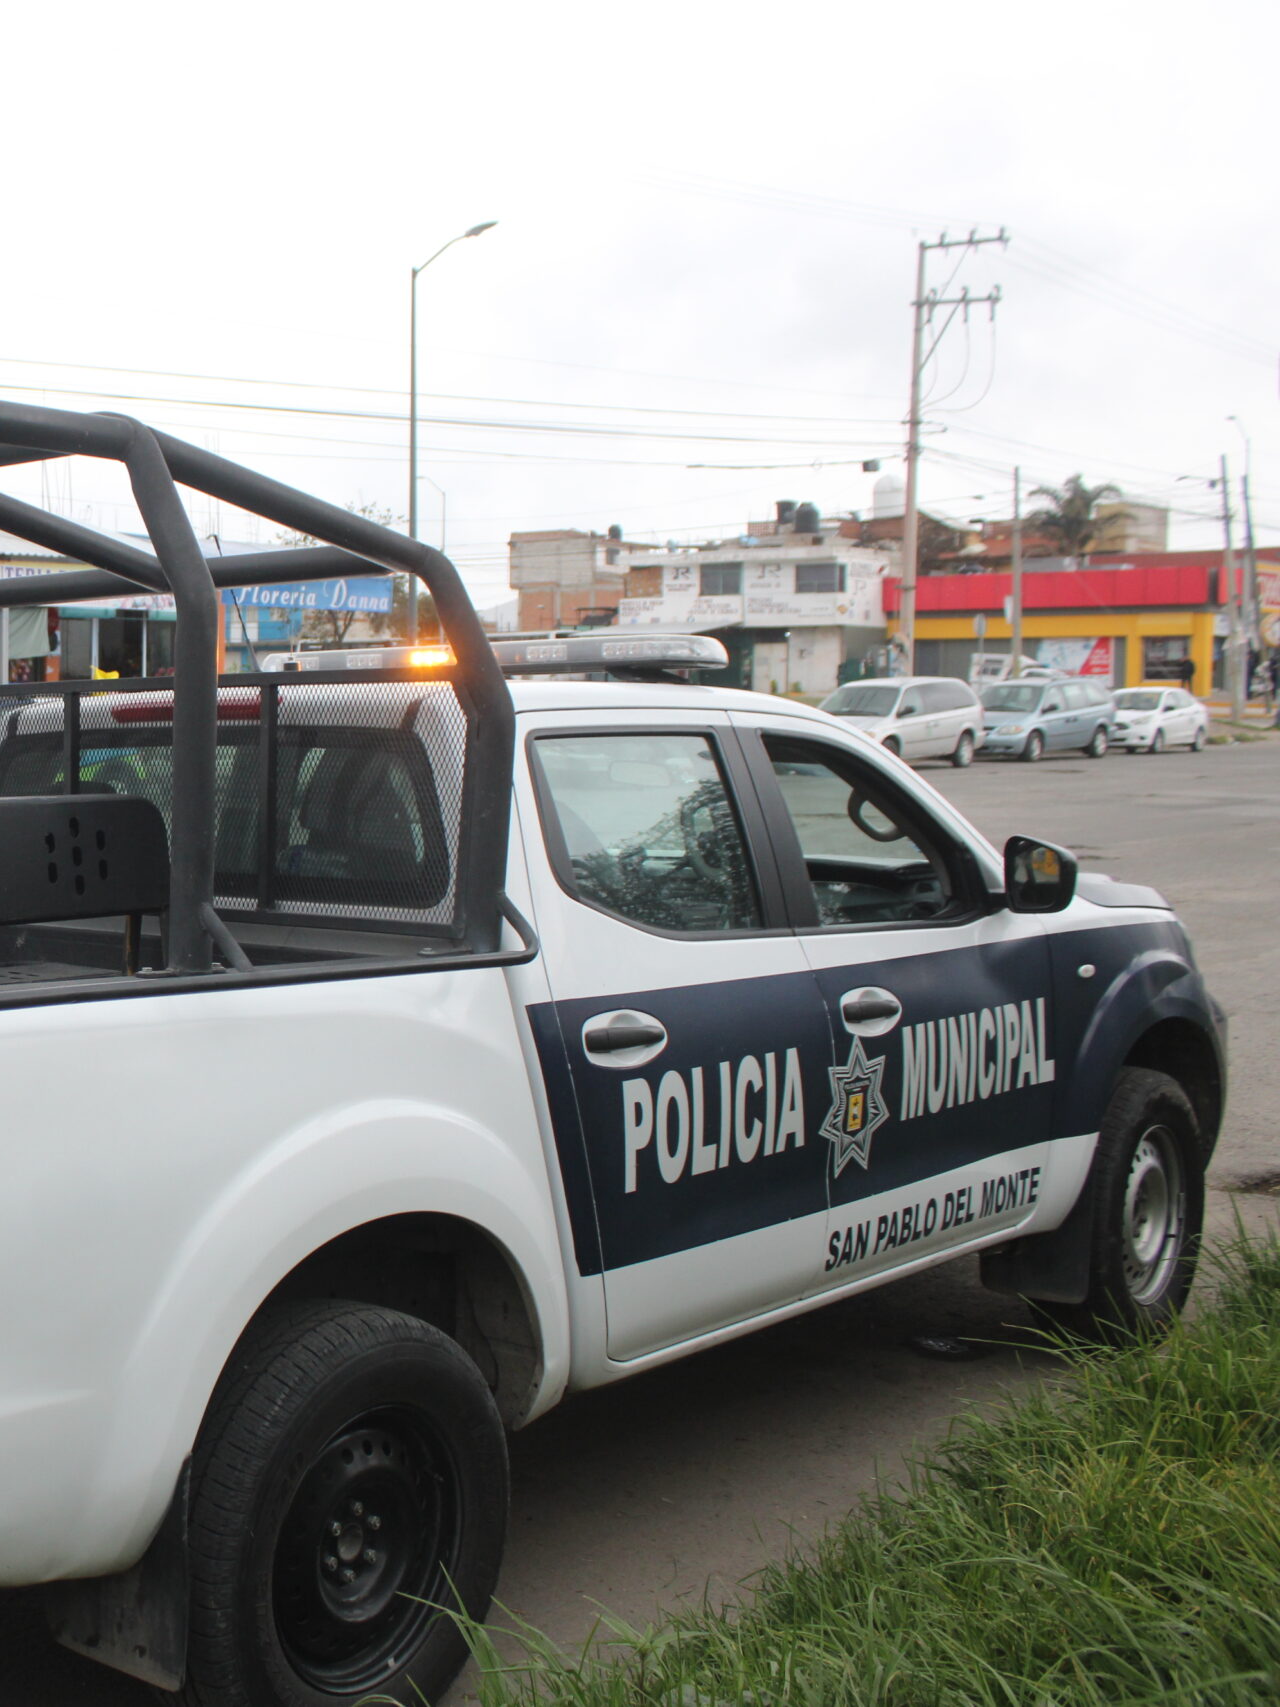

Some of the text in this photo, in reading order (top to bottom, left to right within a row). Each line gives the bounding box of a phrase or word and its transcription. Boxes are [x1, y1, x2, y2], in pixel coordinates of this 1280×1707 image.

[622, 997, 1055, 1194] POLICIA MUNICIPAL
[825, 1166, 1041, 1272] SAN PABLO DEL MONTE
